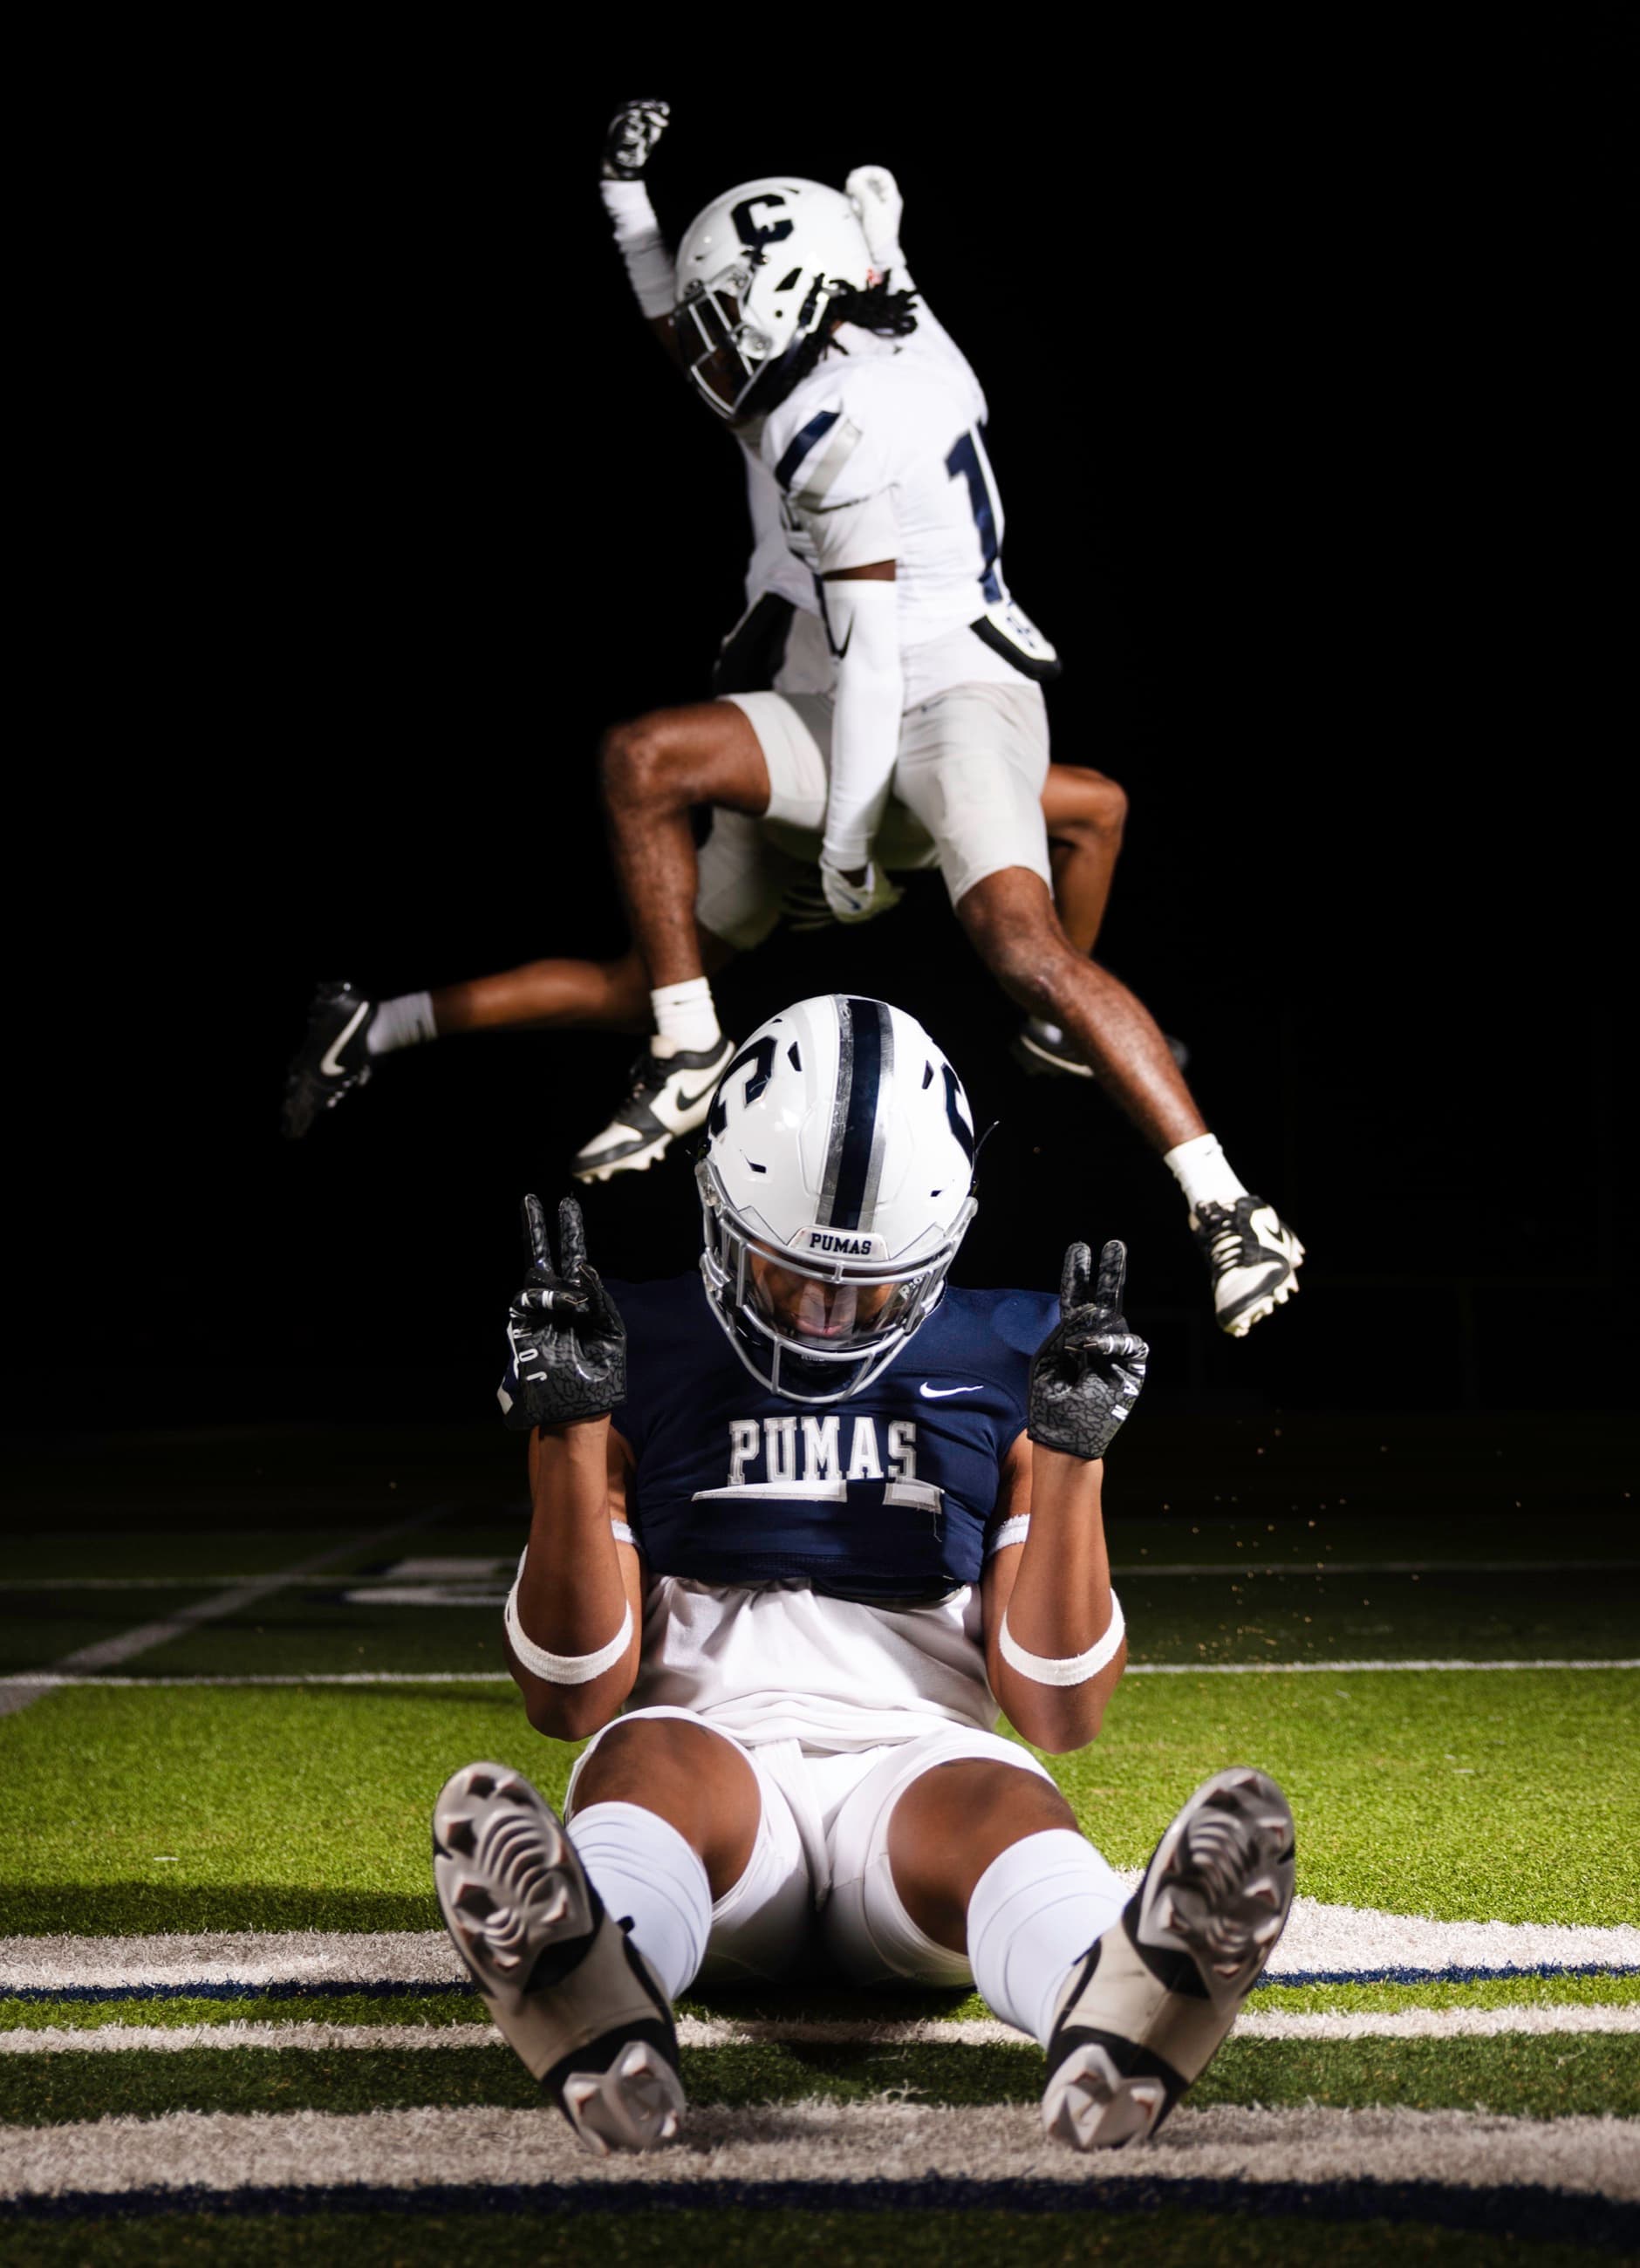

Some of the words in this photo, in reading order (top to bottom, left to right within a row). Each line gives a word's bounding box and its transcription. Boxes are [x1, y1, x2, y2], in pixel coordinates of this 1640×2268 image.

[731, 194, 794, 245] C
[810, 1233, 872, 1255] PUMAS
[728, 1416, 917, 1487] PUMAS
